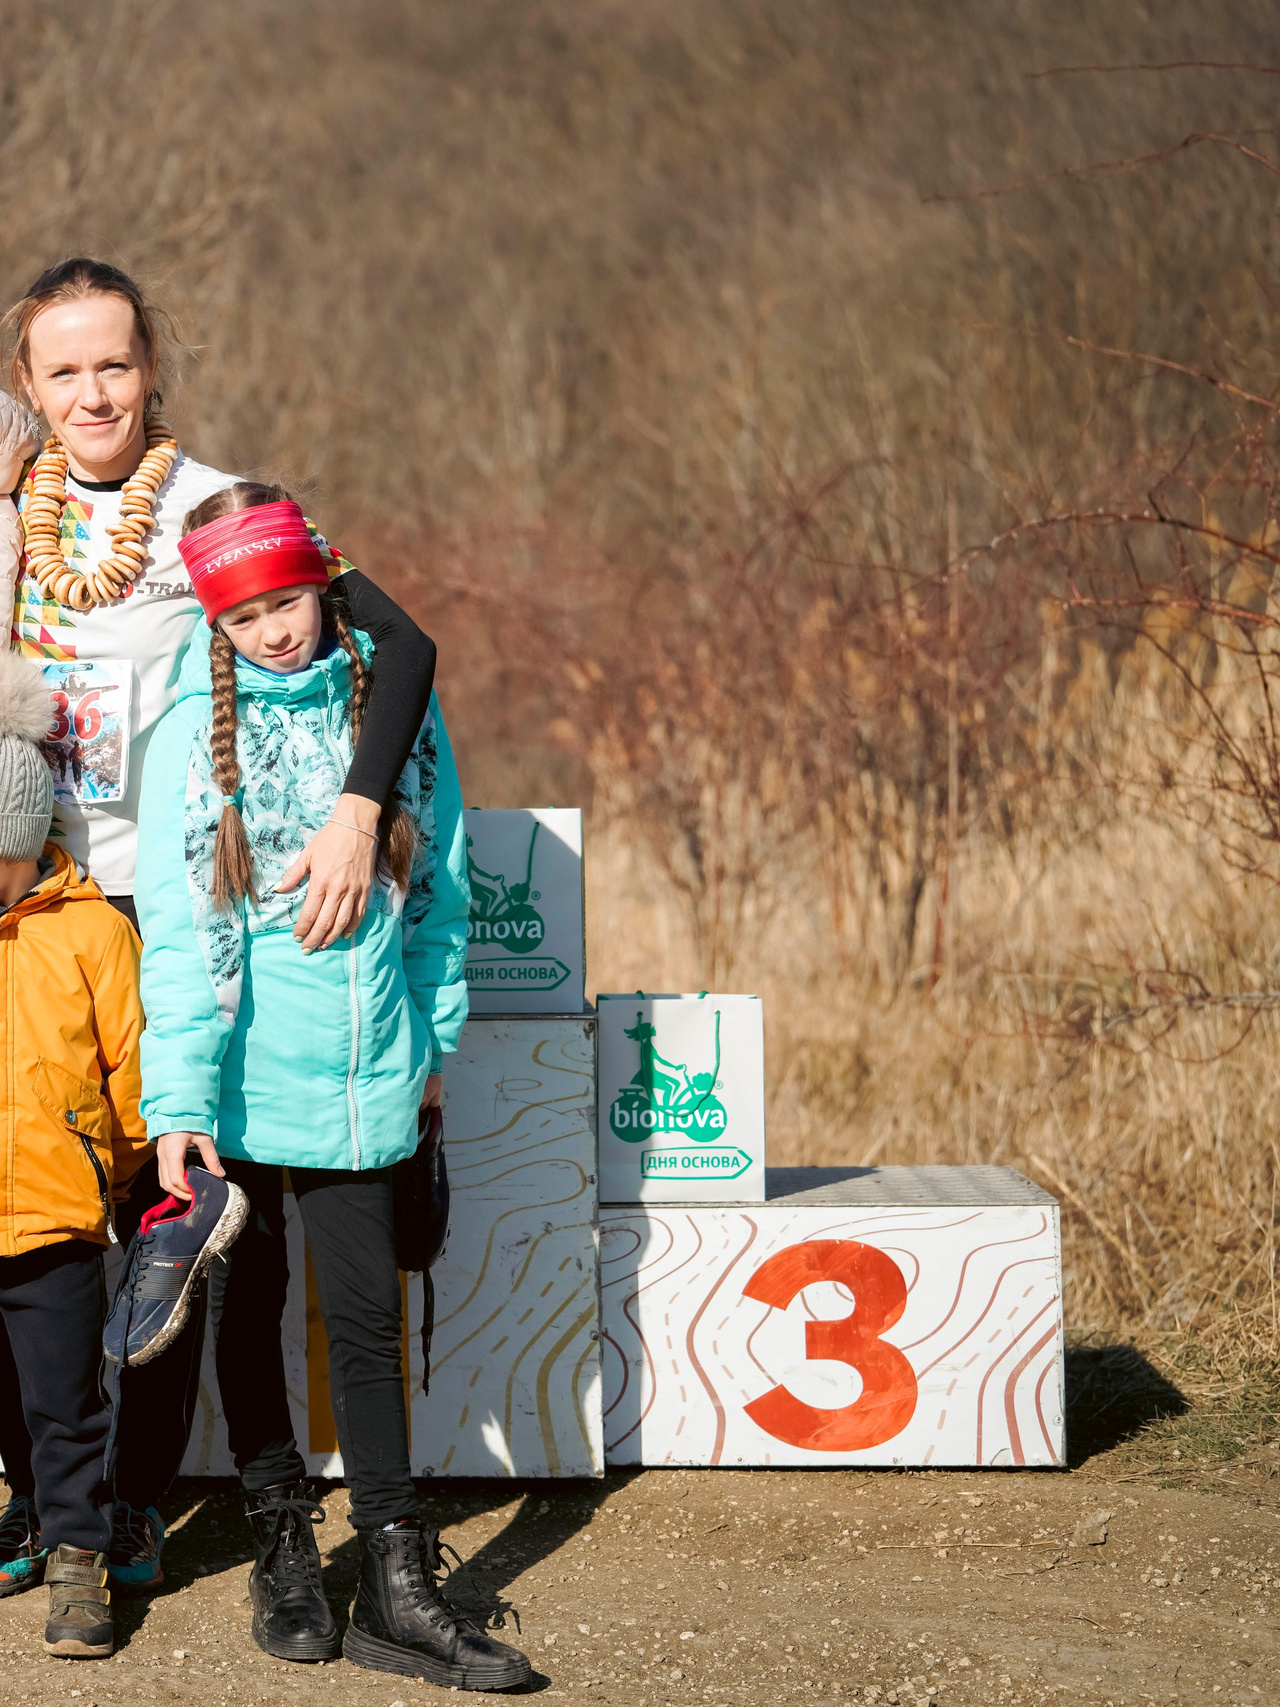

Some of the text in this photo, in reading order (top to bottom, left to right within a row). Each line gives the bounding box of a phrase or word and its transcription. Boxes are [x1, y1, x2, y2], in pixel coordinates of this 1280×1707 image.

[45, 690, 102, 742] 36
[465, 967, 559, 981] ДНЯ ОСНОВА
[614, 1101, 725, 1128] bionova
[646, 1156, 741, 1170] ДНЯ ОСНОВА
[742, 1239, 918, 1452] 3
